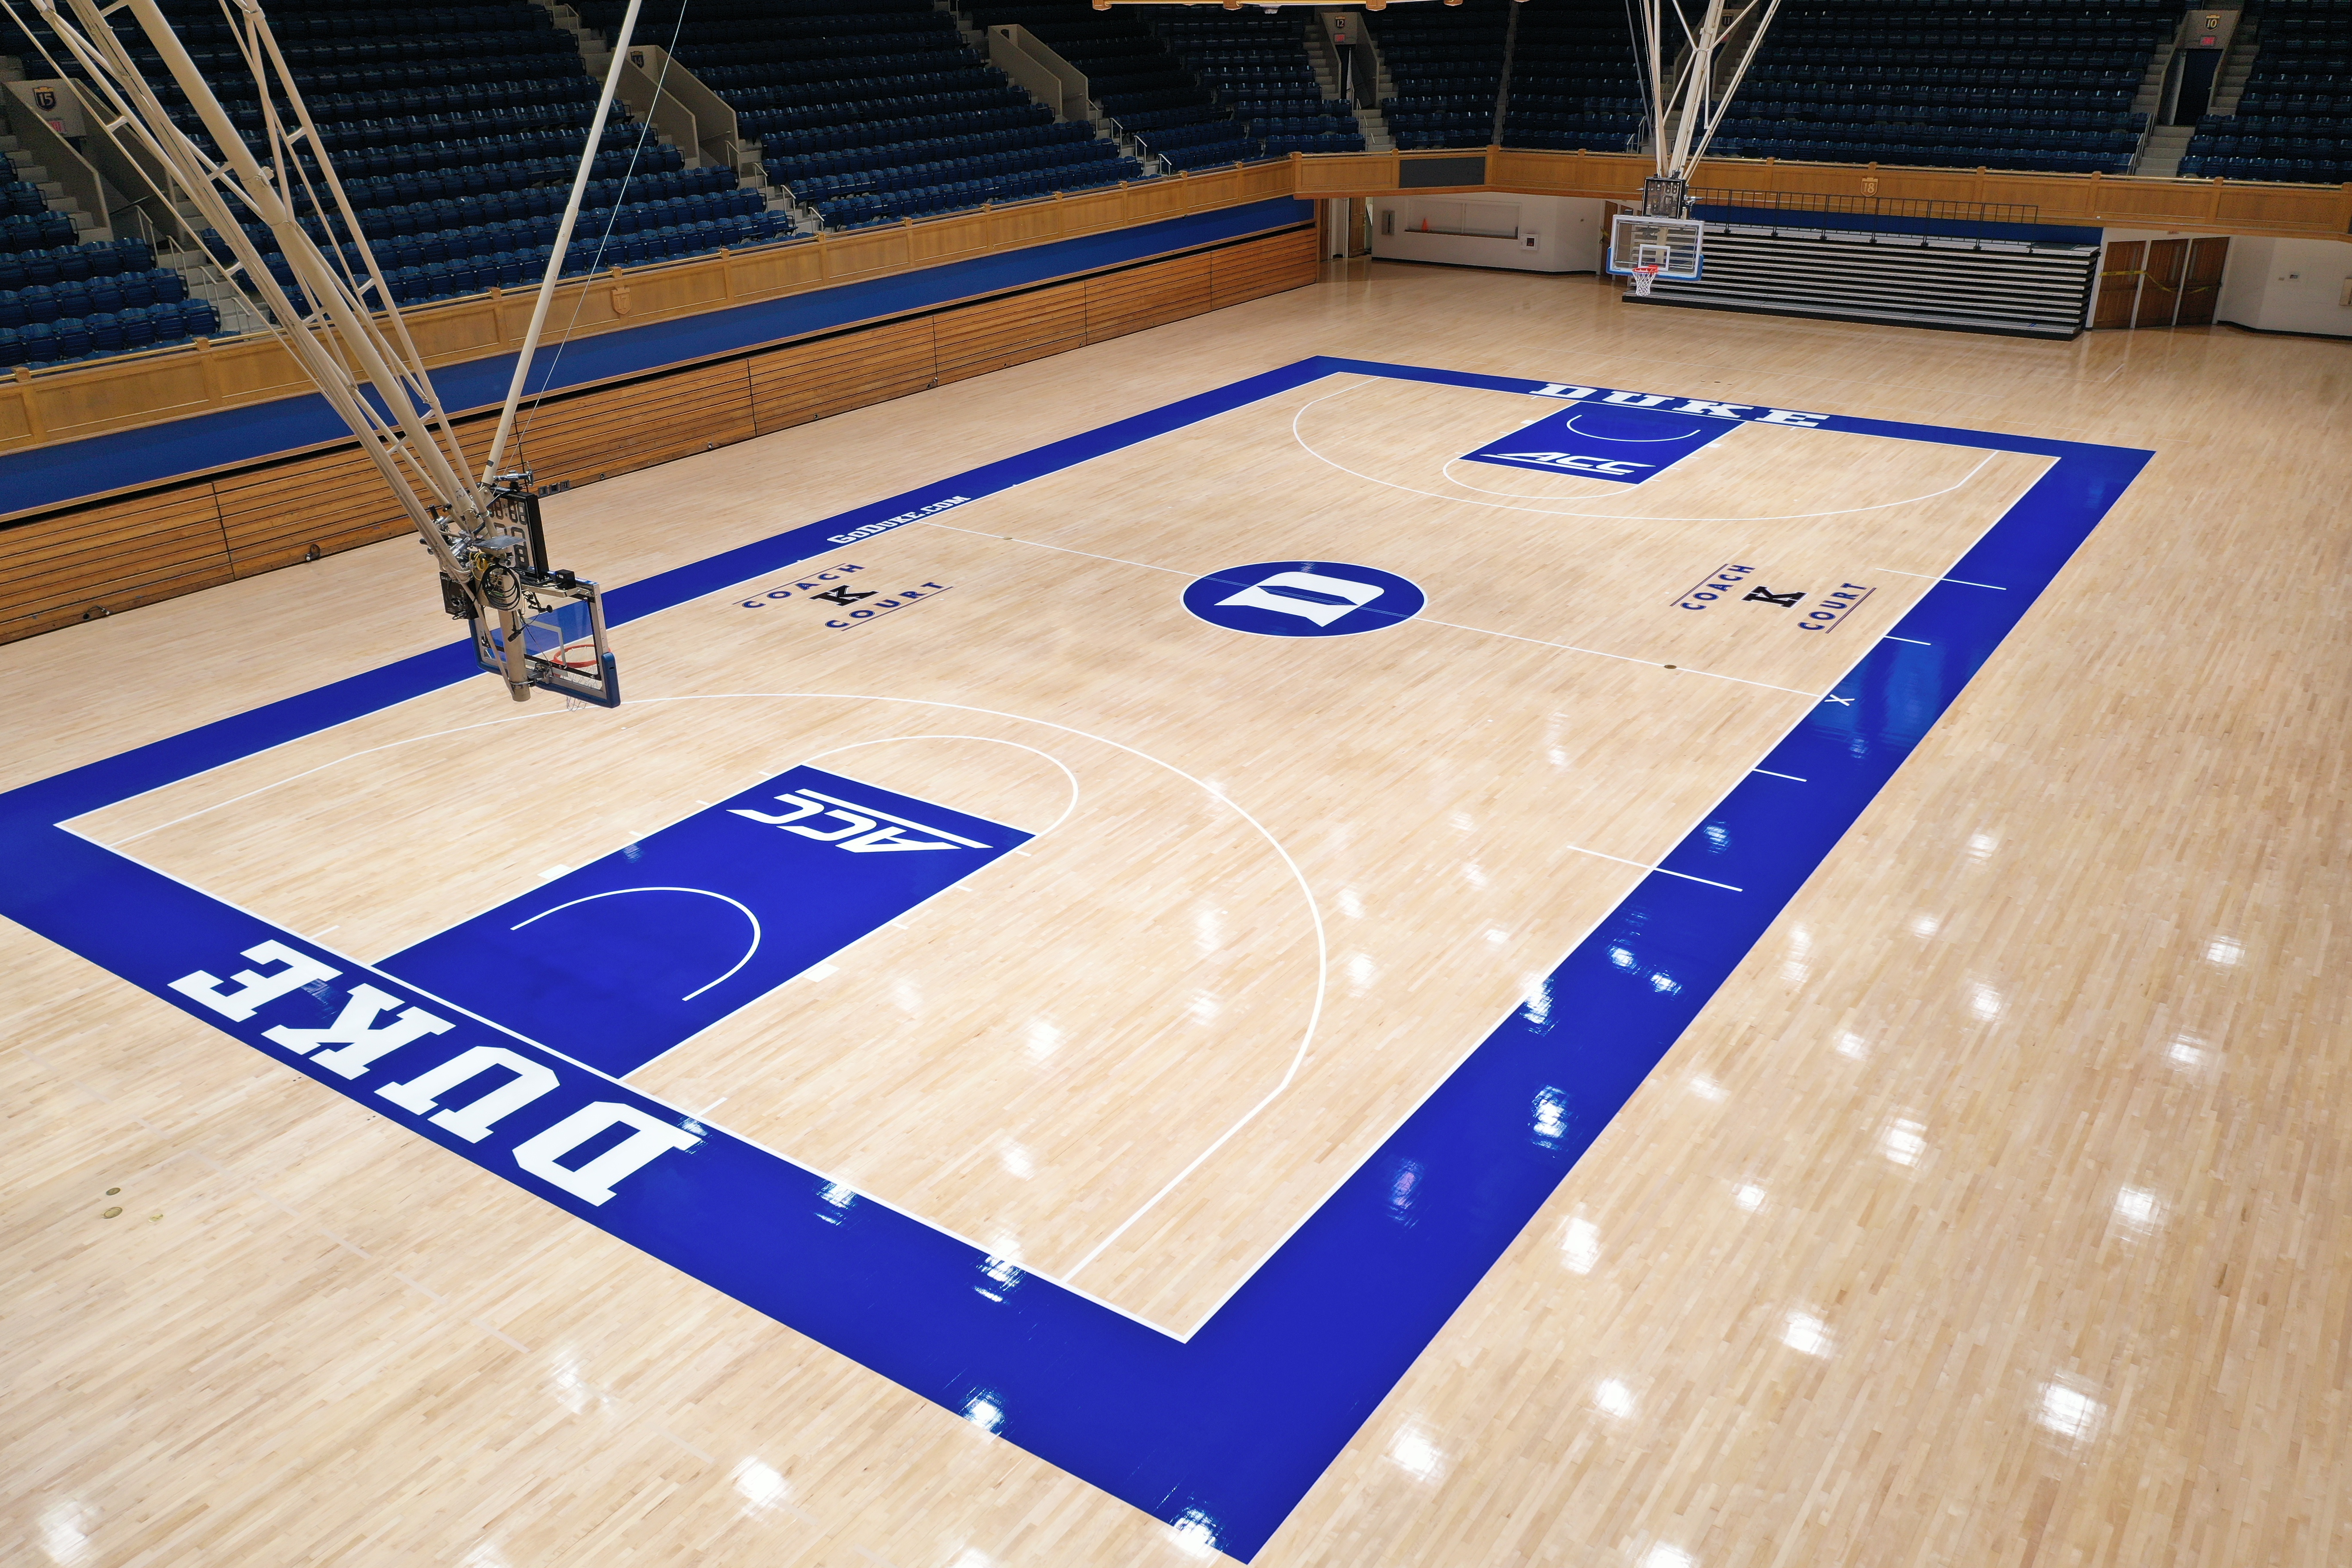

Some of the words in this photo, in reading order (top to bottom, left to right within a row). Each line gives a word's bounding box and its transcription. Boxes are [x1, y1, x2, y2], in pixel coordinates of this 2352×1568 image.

[2207, 19, 2217, 28] 10
[39, 93, 53, 106] 15
[1864, 183, 1874, 193] 18
[1529, 383, 1830, 427] DUKE
[1491, 452, 1656, 474] ACC
[742, 564, 866, 609] COACH
[808, 584, 879, 607] K
[825, 581, 944, 628] COURT
[1680, 564, 1756, 610] COACH
[1740, 585, 1809, 609] K
[1798, 582, 1867, 631] COURT
[726, 791, 976, 853] ACC
[167, 939, 702, 1207] DUKE
